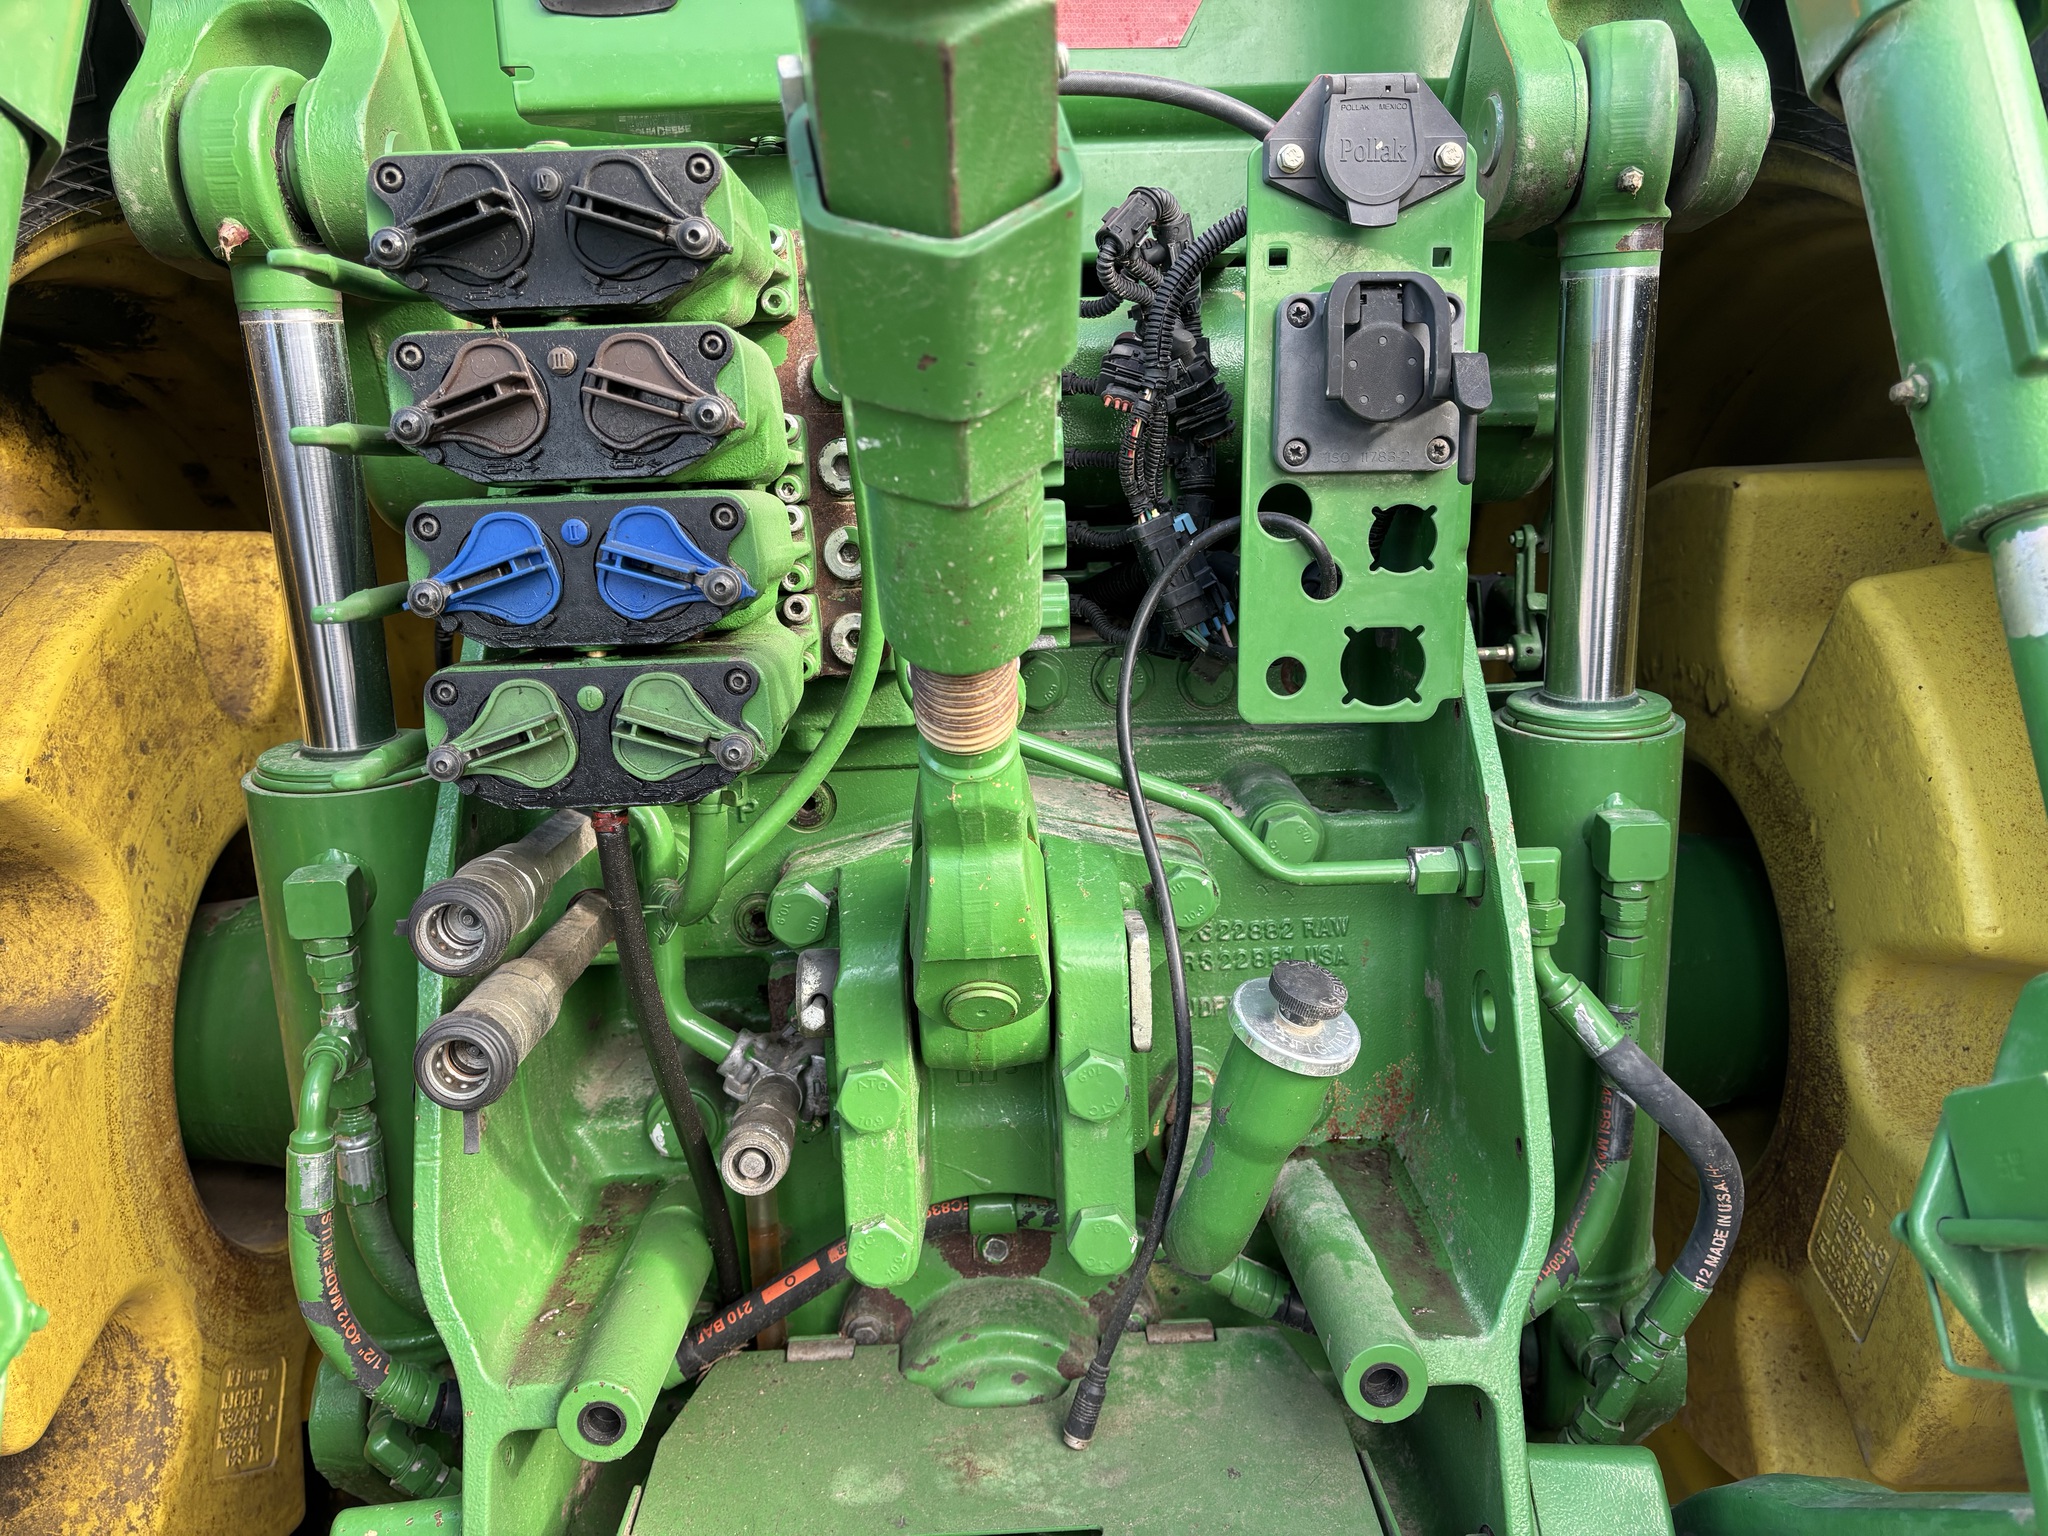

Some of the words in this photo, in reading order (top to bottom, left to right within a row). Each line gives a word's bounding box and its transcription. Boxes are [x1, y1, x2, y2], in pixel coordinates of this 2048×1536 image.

[1340, 103, 1370, 111] POLLAK
[1379, 102, 1408, 111] MEXICO
[1339, 138, 1407, 163] Pollak
[1325, 452, 1350, 463] ISO
[1360, 451, 1410, 463] 11783-2
[776, 903, 792, 926] 10.9
[1184, 904, 1206, 922] 10.9
[1189, 917, 1295, 942] 622882
[1302, 915, 1350, 938] RAW
[1304, 944, 1348, 967] USA
[856, 1077, 888, 1093] ATC
[1088, 1098, 1119, 1117] ATC
[857, 1115, 885, 1128] 10.9
[1599, 1109, 1612, 1136] PSI
[1716, 1214, 1732, 1228] IN
[322, 1244, 335, 1262] IN
[854, 1234, 877, 1263] ATC
[1703, 1229, 1730, 1268] MADE
[884, 1256, 905, 1279] 10.9
[324, 1262, 344, 1312] MADE
[726, 1300, 753, 1327] 210
[337, 1310, 361, 1345] 4Q12
